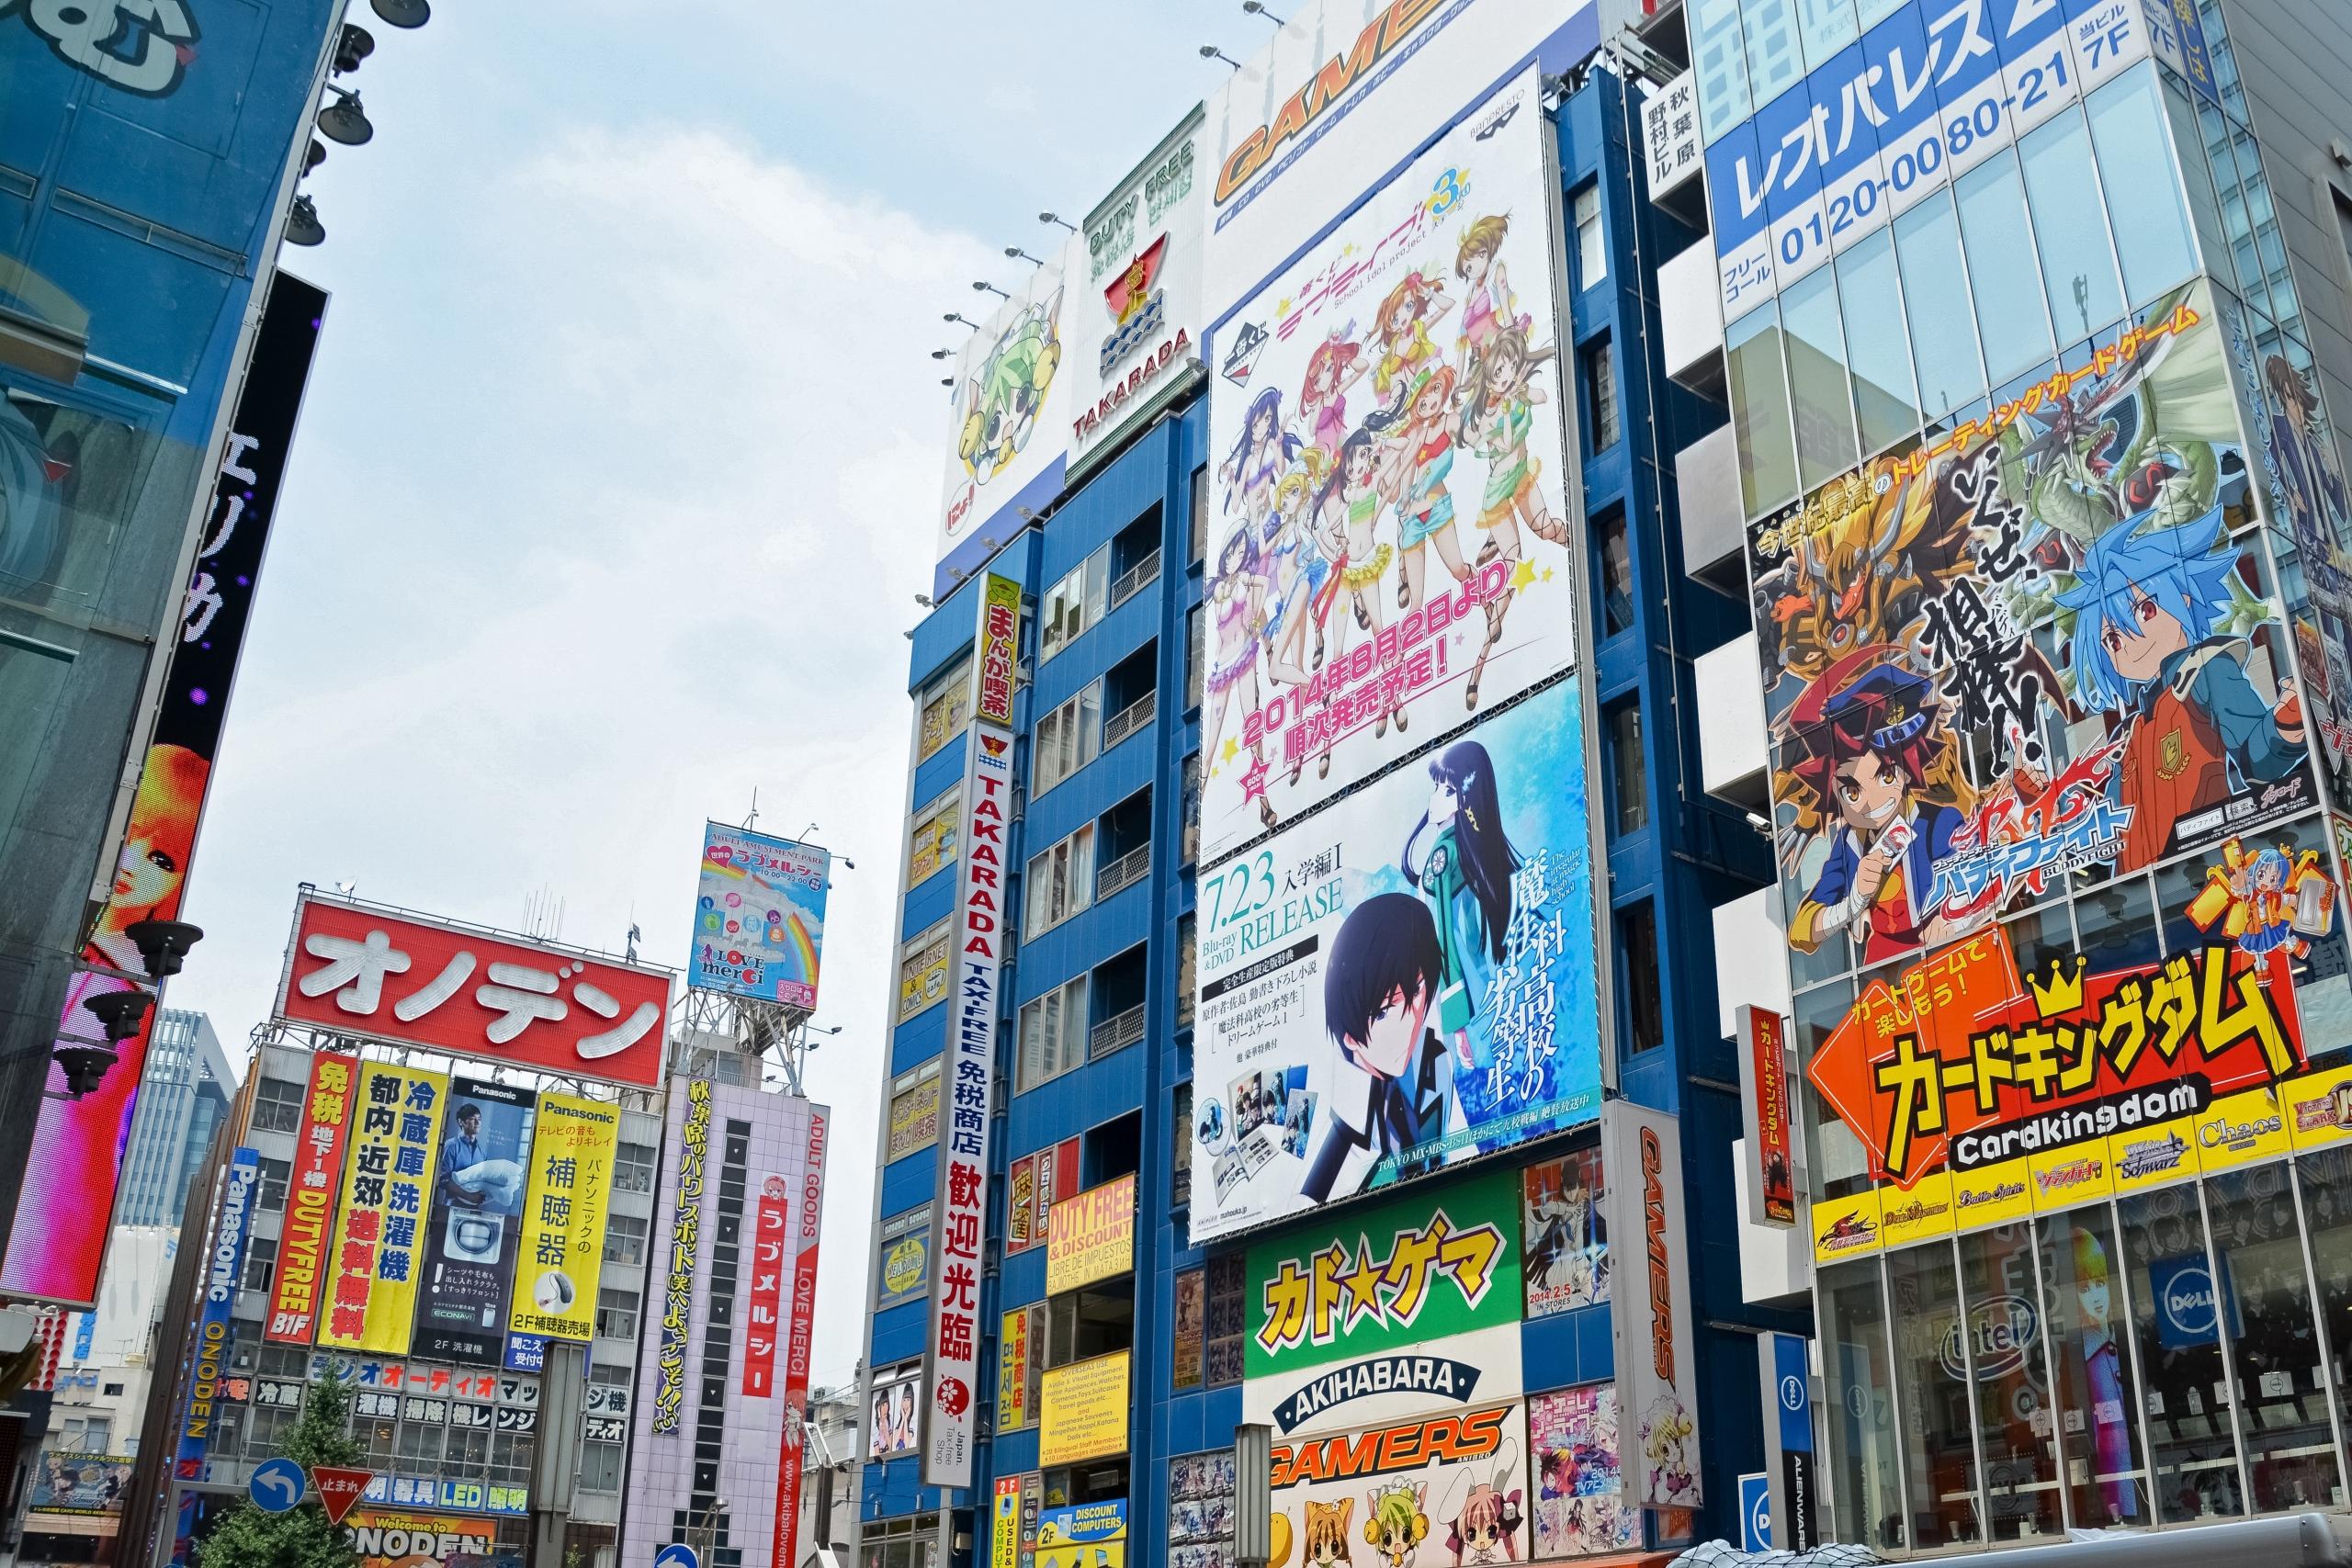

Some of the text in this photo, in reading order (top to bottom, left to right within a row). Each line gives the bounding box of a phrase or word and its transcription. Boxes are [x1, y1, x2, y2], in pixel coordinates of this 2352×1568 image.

[2079, 4, 2124, 37] 当ビル
[2145, 15, 2176, 53] 7F
[2083, 19, 2131, 71] 7F
[1254, 175, 1272, 194] DVD
[1316, 117, 1337, 139] ゲーム
[1344, 90, 1367, 114] トレカ
[1373, 64, 1396, 88] ホビー
[1469, 88, 1526, 138] BANPRESTO
[1669, 85, 1696, 166] 秋葉原
[1647, 103, 1672, 184] 野村ビル
[1090, 140, 1193, 255] DUTY FREE
[1333, 231, 1426, 310] School idol project
[1724, 253, 1766, 288] フリー
[1725, 265, 1770, 304] コール
[1072, 327, 1191, 442] TAKARADA
[981, 604, 1016, 721] まんが喫茶
[1242, 560, 1510, 749] 2014年8月2日より
[1283, 636, 1448, 762] 順次発売予定!
[2180, 814, 2222, 834] バディファイト
[710, 832, 824, 865] ADULT AMUSEMENT PARK
[710, 849, 821, 878] 世界の ラブメルシー
[965, 774, 1005, 960] TAKARADA
[1550, 849, 1566, 863] The
[1550, 847, 1582, 876] irregular
[1922, 801, 2135, 914] バディファイト
[2043, 841, 2126, 879] BUDDYFIGHT
[1551, 879, 1567, 897] high
[1559, 858, 1581, 884] magic
[1203, 851, 1276, 935] 7.23
[1551, 884, 1575, 907] school
[1201, 876, 1345, 957] Blu-ray RELEASE
[701, 961, 764, 986] merci
[717, 949, 765, 970] LOVE
[903, 940, 949, 985] INTERNET
[1222, 948, 1294, 991] 完全生産限定版特典
[300, 930, 661, 1057] オノデン
[1852, 935, 1987, 1025] カードゲームで
[902, 988, 924, 1018] COMICS
[1218, 989, 1299, 1034] 魔法科高校の劣等生
[1874, 973, 1969, 1039] 楽しもう!
[1227, 1016, 1281, 1046] ドリームゲーム
[1245, 1038, 1277, 1060] 豪華特典付
[1876, 946, 2293, 1174] カードキングダム
[311, 1060, 349, 1125] 免税
[471, 1084, 517, 1101] Panasonic
[950, 1059, 988, 1157] 免税商店
[1760, 1032, 1780, 1146] カードキングダム
[538, 1125, 596, 1137] テレビの音も
[543, 1100, 615, 1124] Panasonic
[565, 1135, 612, 1148] よりキレイ
[1378, 1095, 1589, 1172] TOKYO 絶賛放送中
[2198, 1116, 2281, 1147] Chaos
[377, 1079, 437, 1283] 冷蔵庫洗濯機
[802, 1112, 825, 1239] ADULT GOODS
[2121, 1154, 2180, 1179] Schwarz
[535, 1154, 578, 1268] 補聴器
[577, 1158, 603, 1255] パナソニックの
[1012, 1166, 1034, 1240] 麻雀
[1049, 1179, 1133, 1244] DUTY FREE
[1219, 1205, 1248, 1219] mahouka.jp
[1957, 1182, 2026, 1208] Battle Spirits
[209, 1163, 259, 1303] Panasonic
[281, 1189, 328, 1315] DUTYFREE
[1049, 1219, 1132, 1261] & DISCOUNT
[447, 1267, 494, 1280] シーツや毛布も
[939, 1160, 983, 1362] 歓迎光臨
[1048, 1238, 1132, 1278] LIBRE DE IMPUESTOS
[1637, 1125, 1676, 1393] GAMERS
[445, 1276, 500, 1291] 出し入れラクラク。
[748, 1208, 783, 1392] ラブメルシー
[1529, 1283, 1571, 1306] 2014.2.5
[2171, 1290, 2214, 1312] DELL
[434, 1310, 472, 1321] ECONAVI
[789, 1267, 813, 1376] LOVE MERCI
[1544, 1297, 1571, 1311] STORES
[269, 1310, 312, 1337] B1F
[514, 1314, 591, 1338] 2F補聴器売場
[1951, 1312, 2024, 1358] intel
[435, 1339, 483, 1355] 2F 洗濯機
[1012, 1314, 1026, 1409] 免税商店
[186, 1321, 226, 1438] ONODEN
[1000, 1342, 1012, 1426] 면세점
[1048, 1366, 1123, 1389] Audio Visual Equipment
[1061, 1363, 1094, 1377] OVERSEAS
[1046, 1388, 1063, 1396] Home
[1295, 1359, 1453, 1422] AKIHABARA
[1056, 1410, 1113, 1427] Japanese Souvenirs
[1068, 1433, 1080, 1441] Dolls
[935, 1439, 945, 1465] Shop
[945, 1427, 956, 1466] Tax-free
[956, 1431, 966, 1466] Japan.
[1054, 1436, 1122, 1454] Bilingual Staff Members
[1057, 1444, 1118, 1461] Languages available
[1270, 1405, 1515, 1490] GAMERS
[1456, 1451, 1491, 1463] ANIBRO
[322, 1478, 359, 1494] 止まれ
[1793, 1455, 1806, 1553] ALIENWARE
[374, 1516, 447, 1533] Welcome to
[1071, 1517, 1122, 1533] COMPUTERS
[1076, 1504, 1118, 1519] DISCOUNT
[1042, 1528, 1054, 1544] 2F
